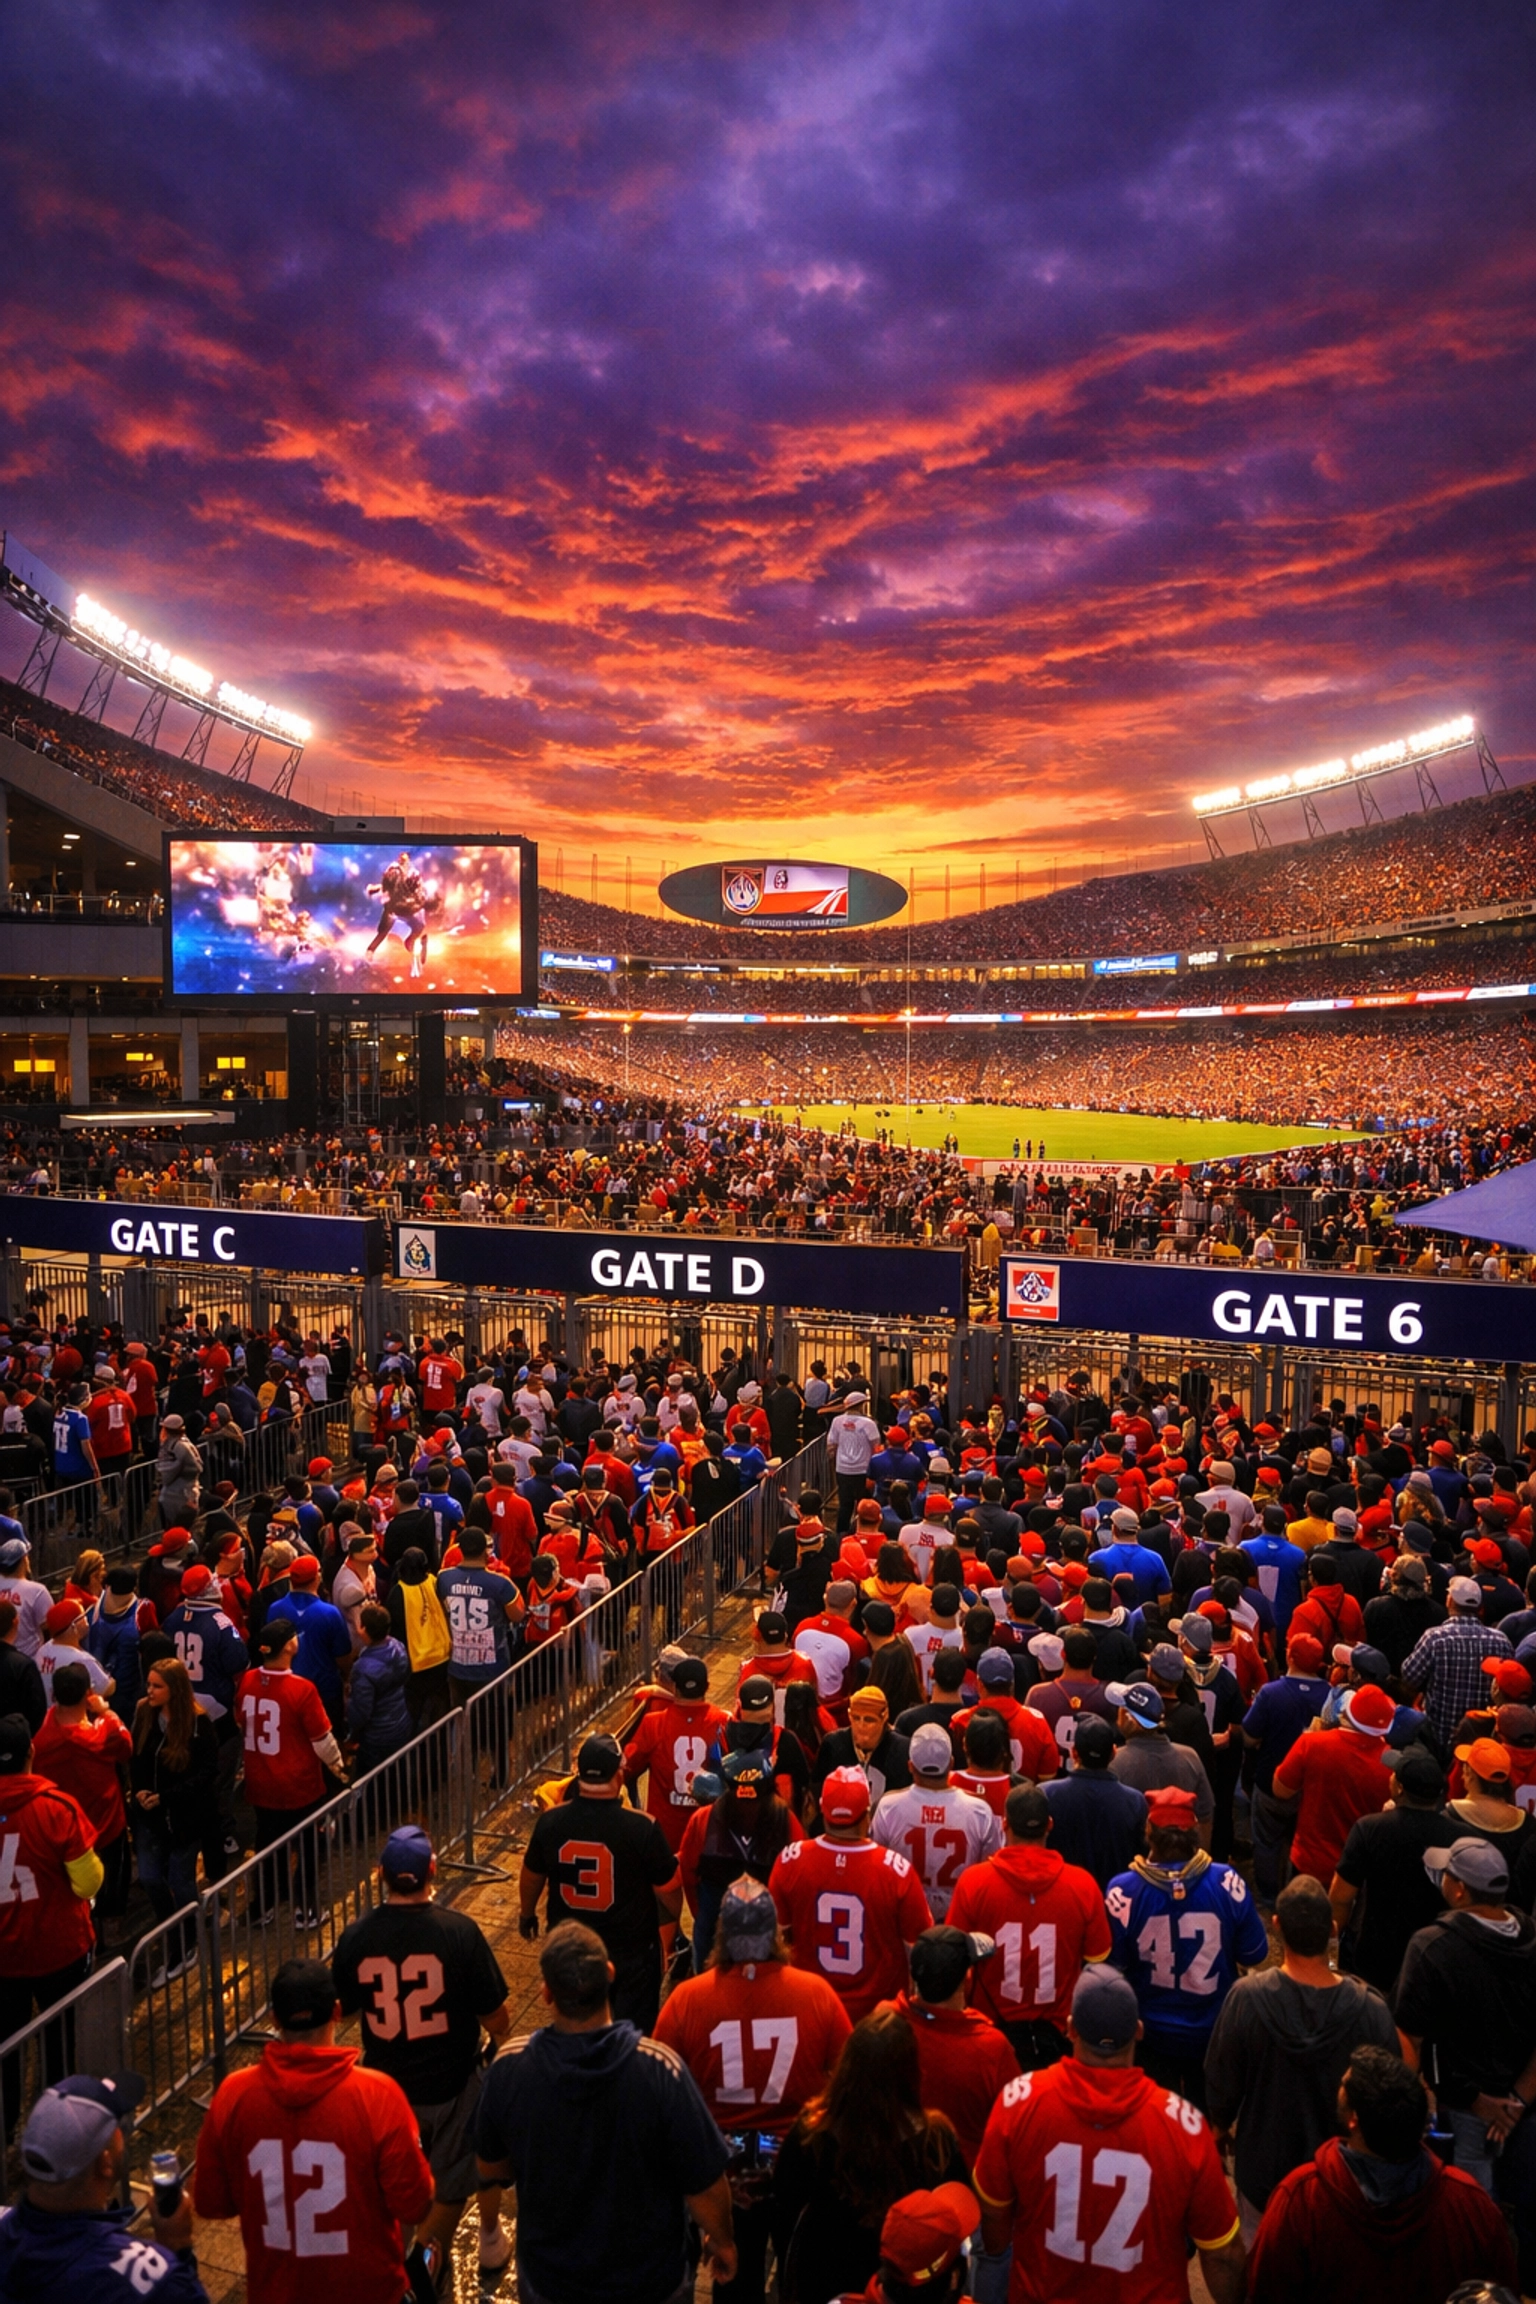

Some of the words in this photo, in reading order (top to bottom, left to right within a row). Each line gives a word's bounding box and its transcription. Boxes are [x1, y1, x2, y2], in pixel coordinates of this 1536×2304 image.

[111, 1218, 199, 1258] GATE
[213, 1226, 236, 1261] C
[591, 1249, 711, 1293] GATE
[732, 1257, 765, 1295] D
[1212, 1290, 1363, 1341] GATE
[1388, 1302, 1423, 1344] 6
[242, 1695, 281, 1756] 13
[558, 1840, 615, 1912] 3
[904, 1827, 968, 1887] 12
[816, 1891, 865, 1976] 3
[995, 1921, 1057, 2005] 11
[1136, 1911, 1222, 1996] 42
[357, 1953, 449, 2041] 32
[708, 2016, 799, 2104] 17
[248, 2138, 349, 2257] 12
[1044, 2141, 1153, 2273] 12
